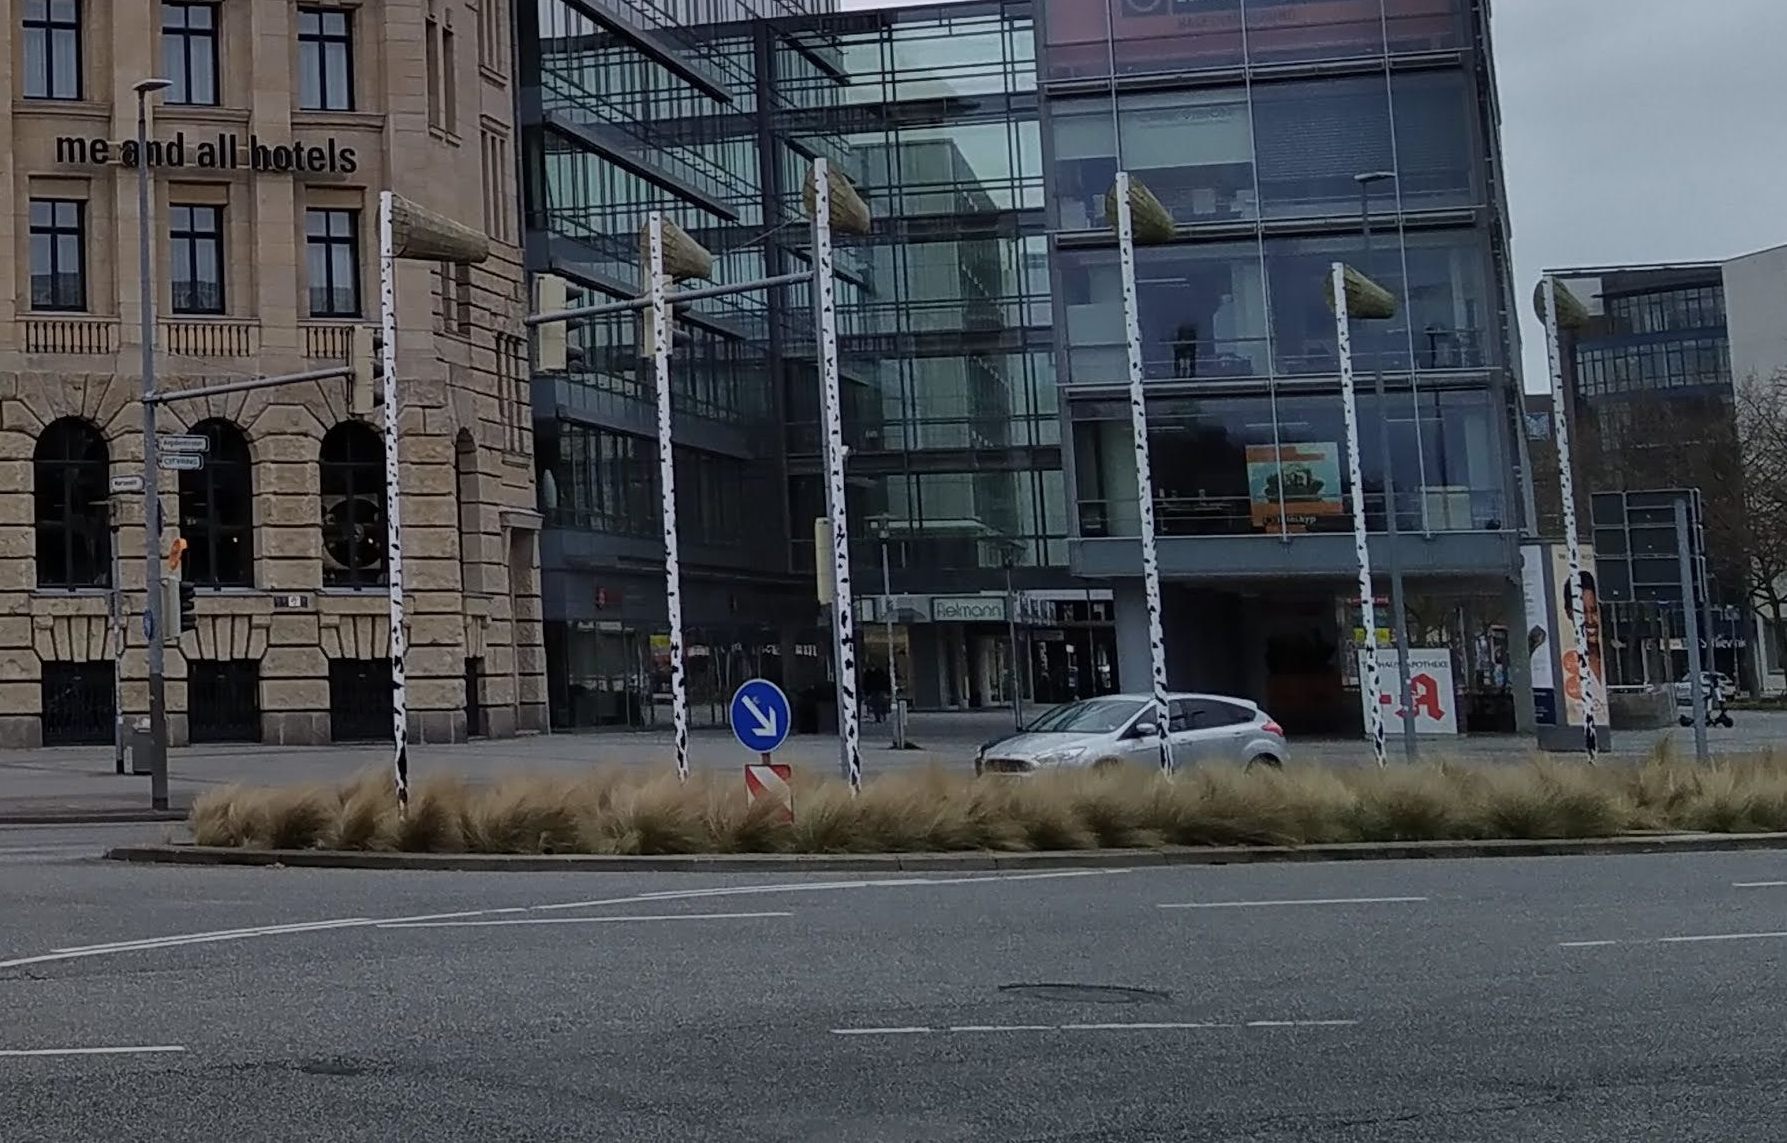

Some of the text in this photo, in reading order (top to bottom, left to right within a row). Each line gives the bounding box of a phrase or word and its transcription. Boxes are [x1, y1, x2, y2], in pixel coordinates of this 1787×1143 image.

[56, 132, 358, 173] me and all hotels
